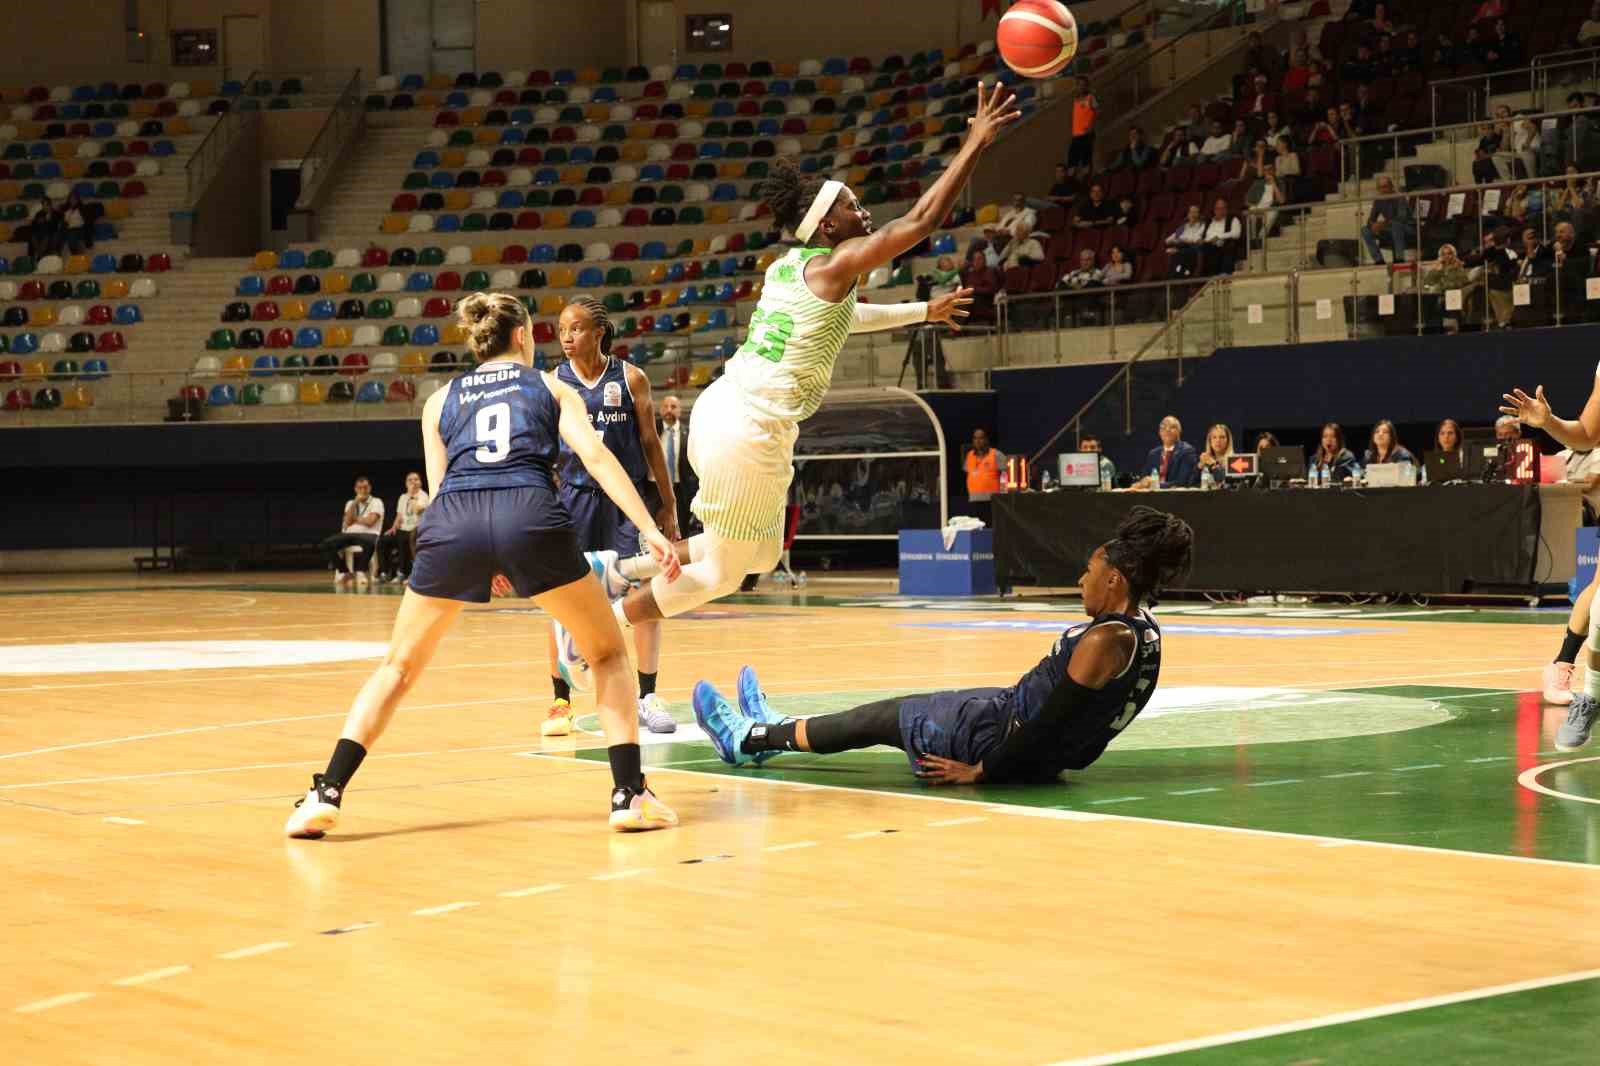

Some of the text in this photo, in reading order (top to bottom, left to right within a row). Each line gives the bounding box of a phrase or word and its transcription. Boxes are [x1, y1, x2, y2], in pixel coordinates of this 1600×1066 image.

[461, 369, 520, 388] AKGÜN
[476, 402, 511, 463] 9
[1007, 458, 1028, 488] 11
[1515, 443, 1534, 479] 2
